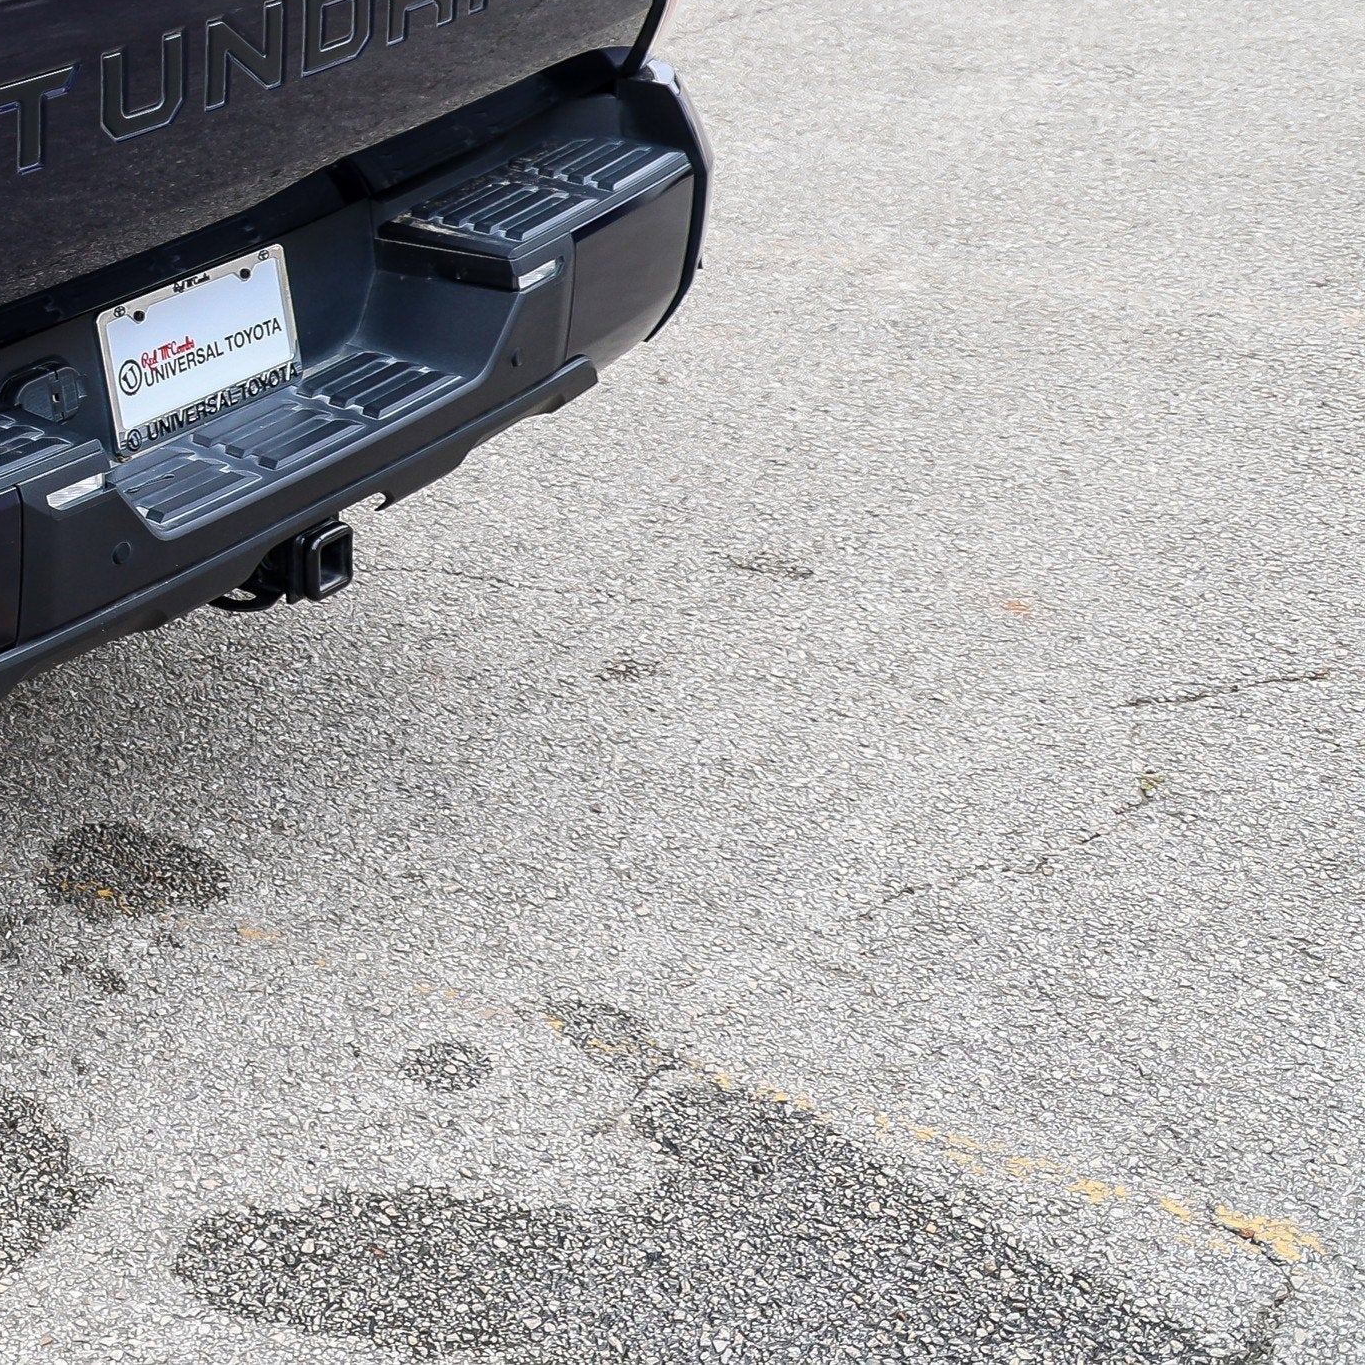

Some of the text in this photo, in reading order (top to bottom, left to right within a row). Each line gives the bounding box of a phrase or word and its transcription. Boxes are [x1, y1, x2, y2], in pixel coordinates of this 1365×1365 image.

[143, 341, 224, 387] UNIVERSAL
[225, 318, 282, 352] TOYOTA
[146, 389, 241, 441] UNIVERSAL
[239, 361, 299, 401] TOYOTA
